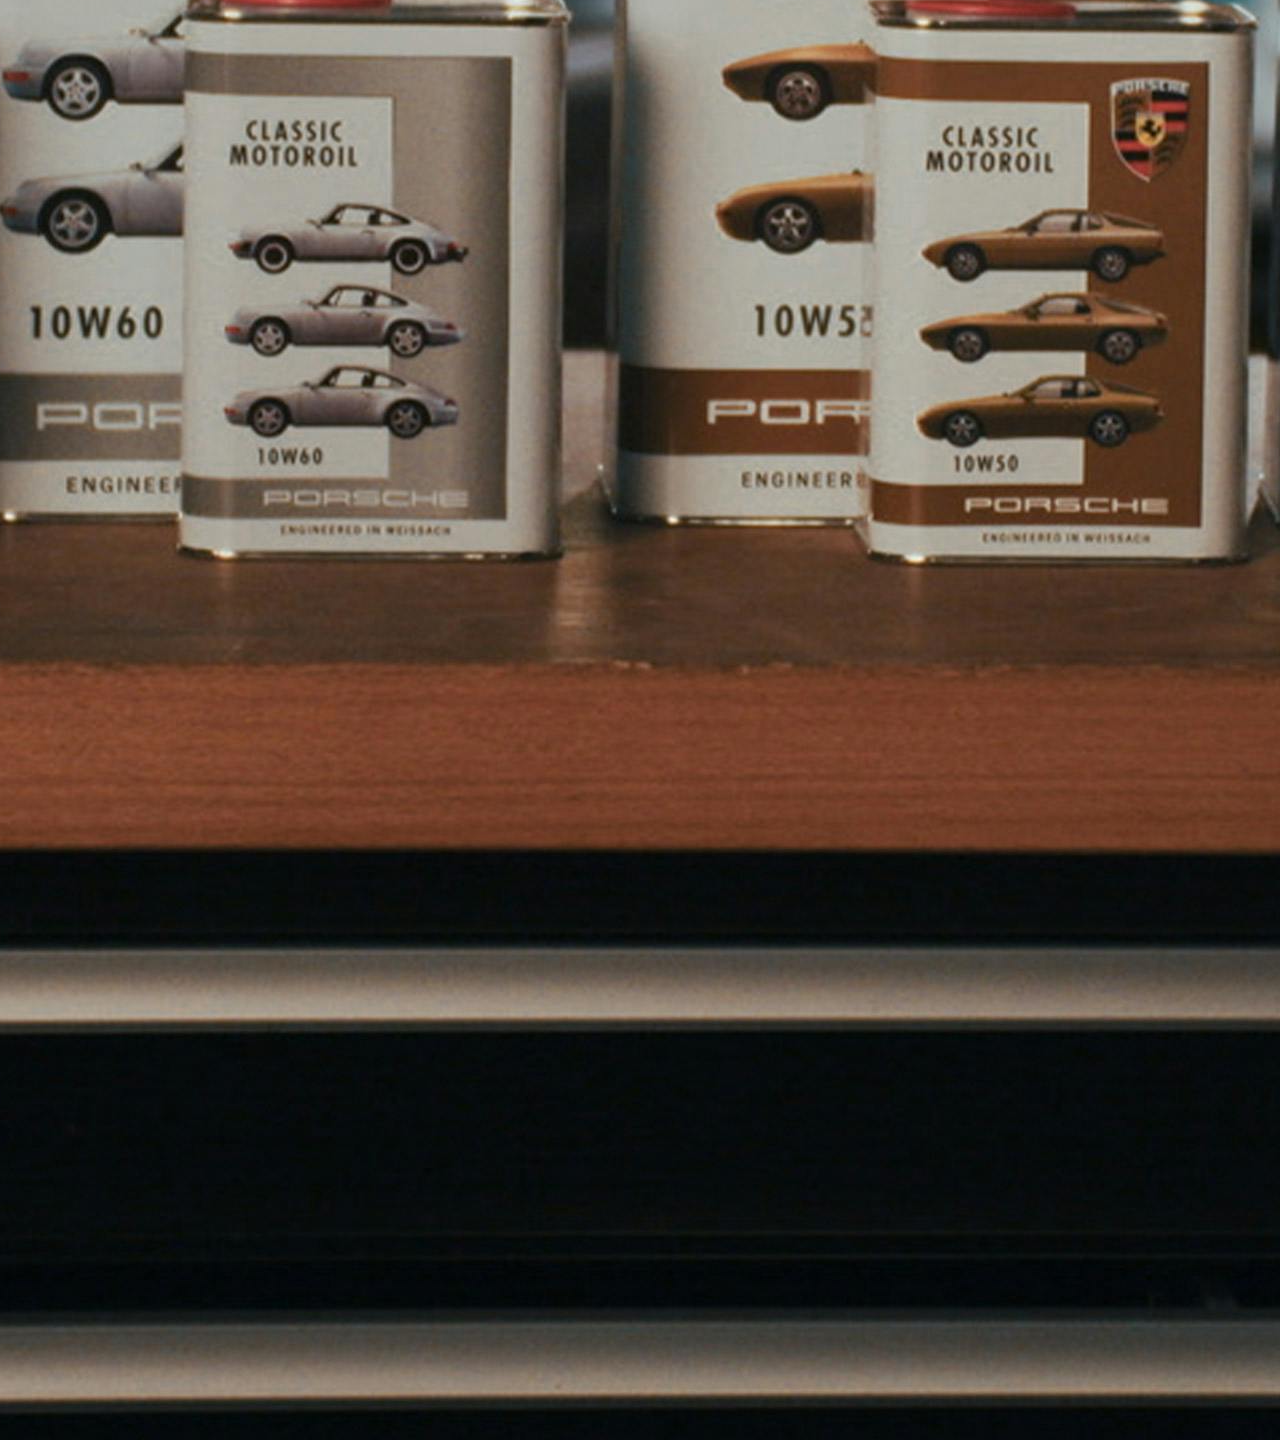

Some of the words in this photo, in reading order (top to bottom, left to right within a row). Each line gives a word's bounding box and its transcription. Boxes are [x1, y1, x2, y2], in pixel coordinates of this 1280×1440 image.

[245, 120, 343, 143] CLASSIC
[942, 126, 1039, 149] CLASSIC
[229, 145, 358, 167] MOTOROIL
[925, 151, 1054, 174] MOTOROIL
[29, 305, 164, 340] 10W60
[257, 447, 324, 466] 10W60
[954, 454, 1020, 473] 10W50
[263, 489, 469, 508] PORSCHE
[964, 497, 1169, 514] PORSCHE
[280, 524, 363, 536] ENGINEERED
[366, 525, 382, 536] IN
[385, 525, 452, 537] WEISSACH
[982, 532, 1063, 543] ENGINEERED
[1066, 532, 1080, 543] IN
[1084, 532, 1152, 544] WEISSACH
